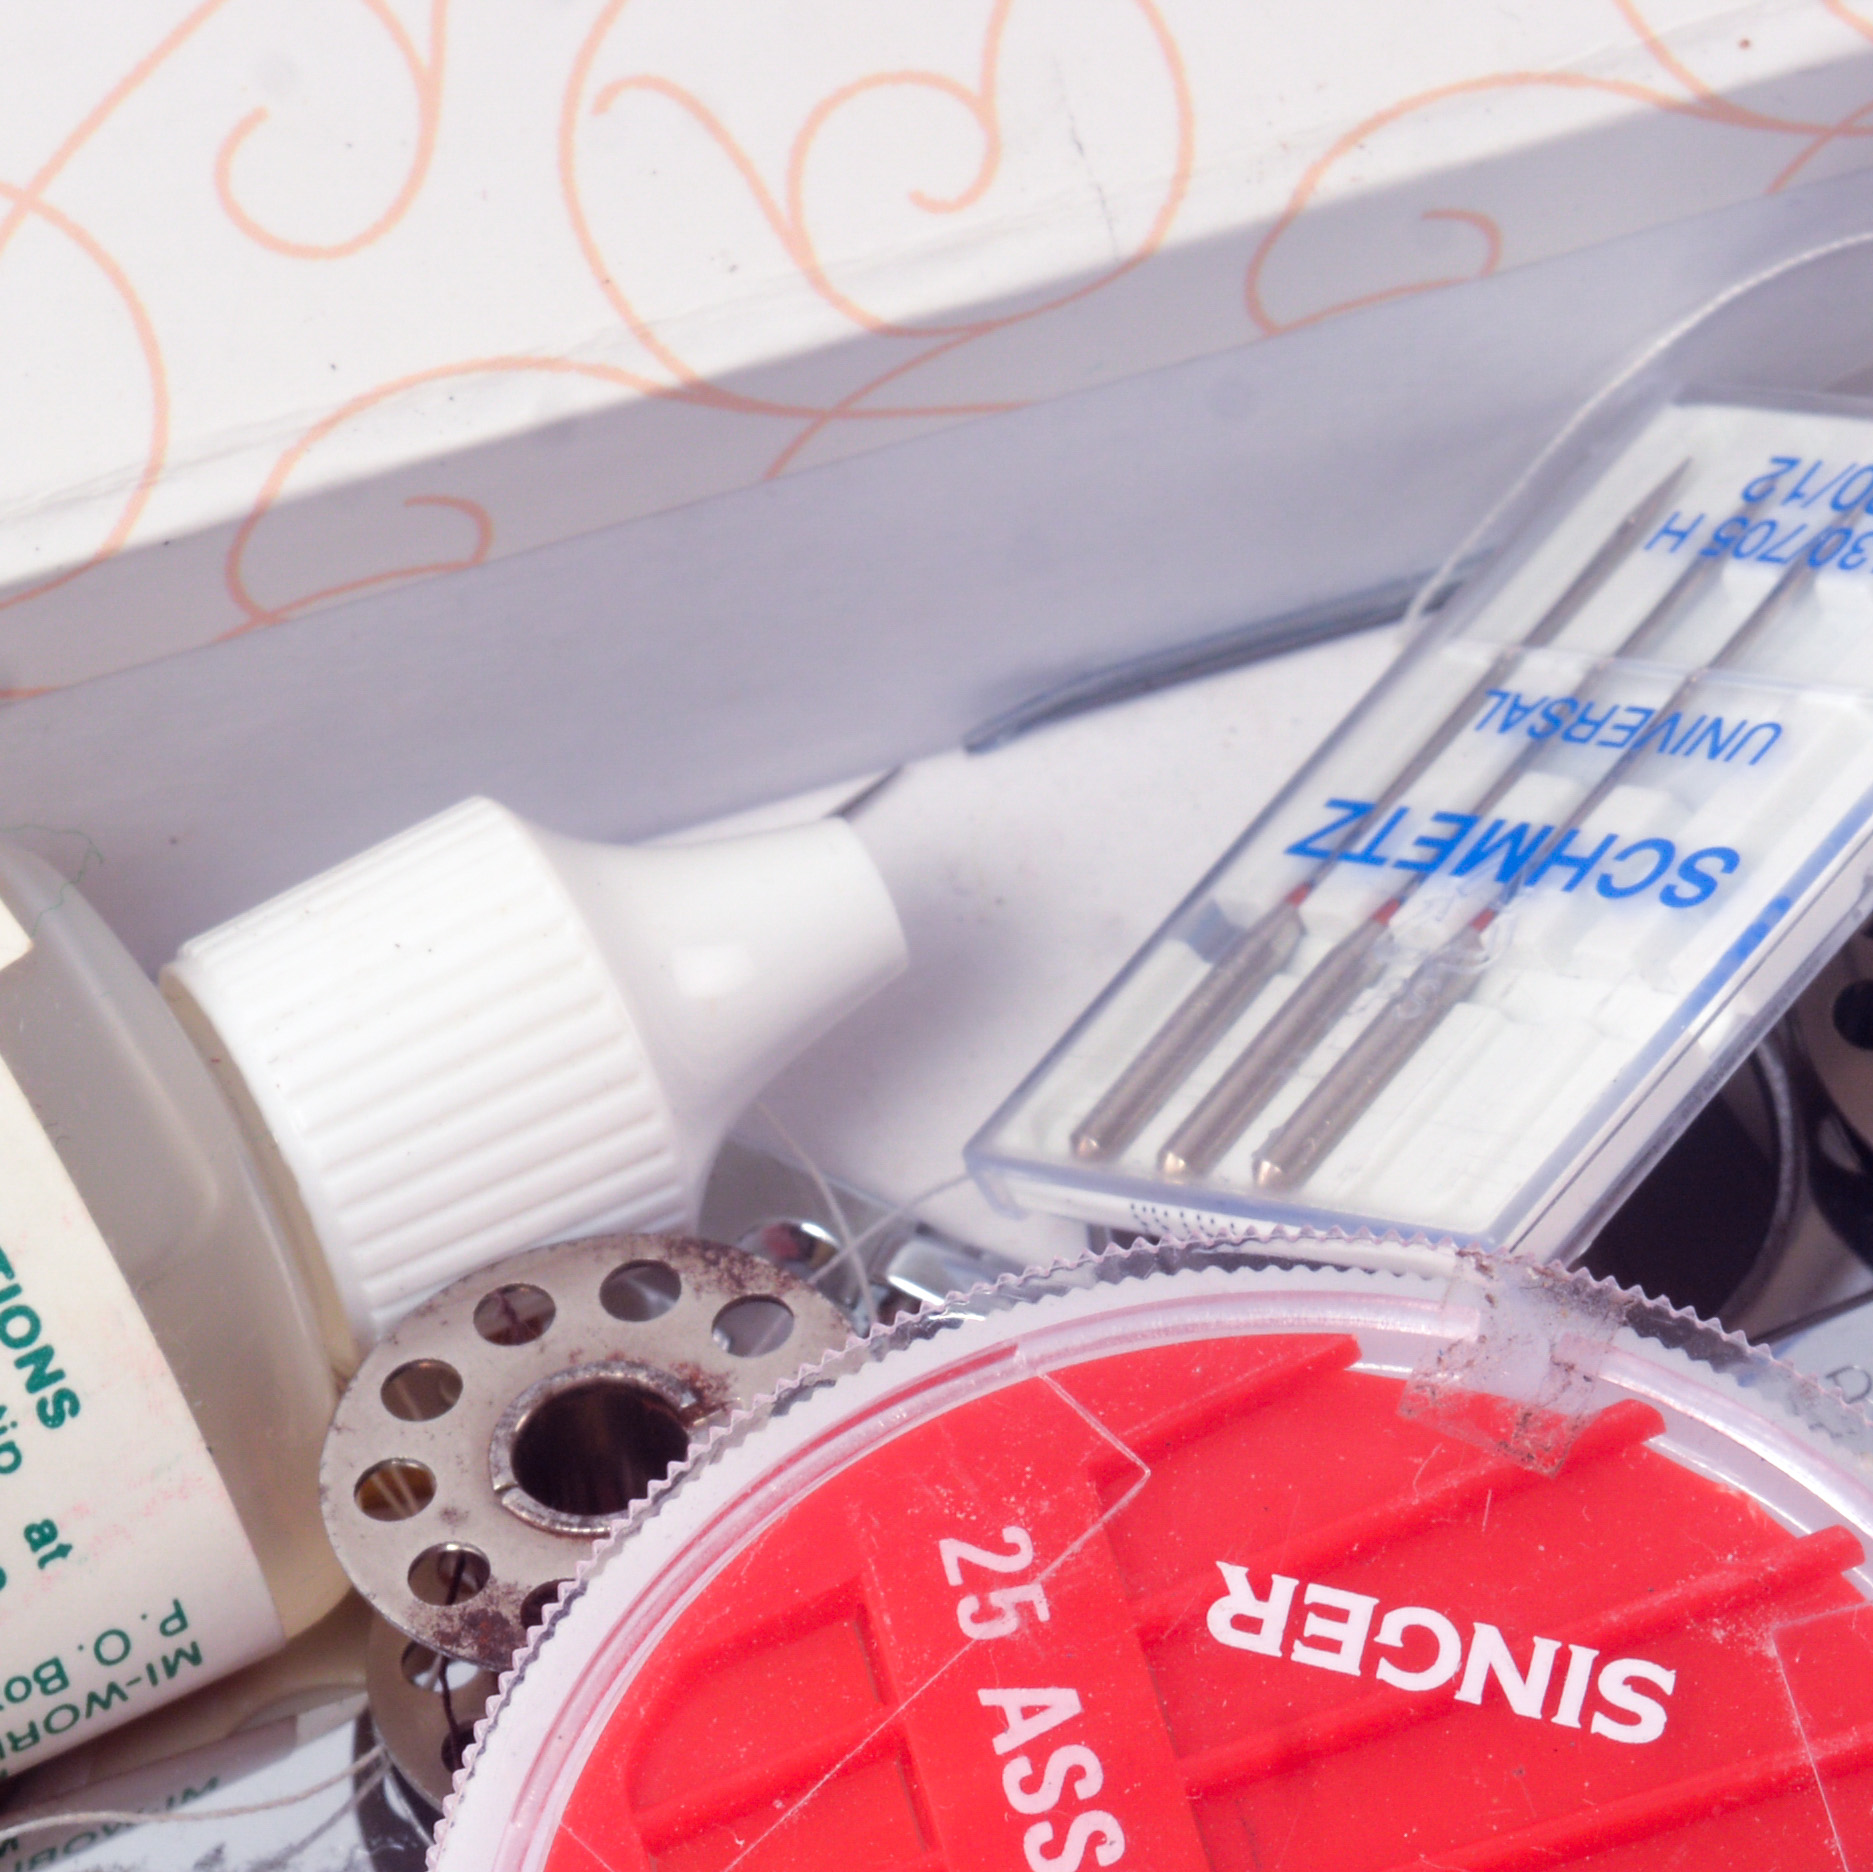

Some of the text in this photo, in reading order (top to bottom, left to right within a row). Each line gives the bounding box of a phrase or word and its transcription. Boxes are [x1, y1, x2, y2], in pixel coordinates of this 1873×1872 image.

[1650, 511, 1701, 551] H
[1478, 690, 1782, 764] UNIVERSAL
[1286, 799, 1740, 909] SCHMETZ
[24, 1519, 72, 1568] at
[939, 1526, 1050, 1640] 25
[77, 1628, 135, 1668] O.
[140, 1598, 190, 1638] P.
[1207, 1561, 1676, 1743] SINGER
